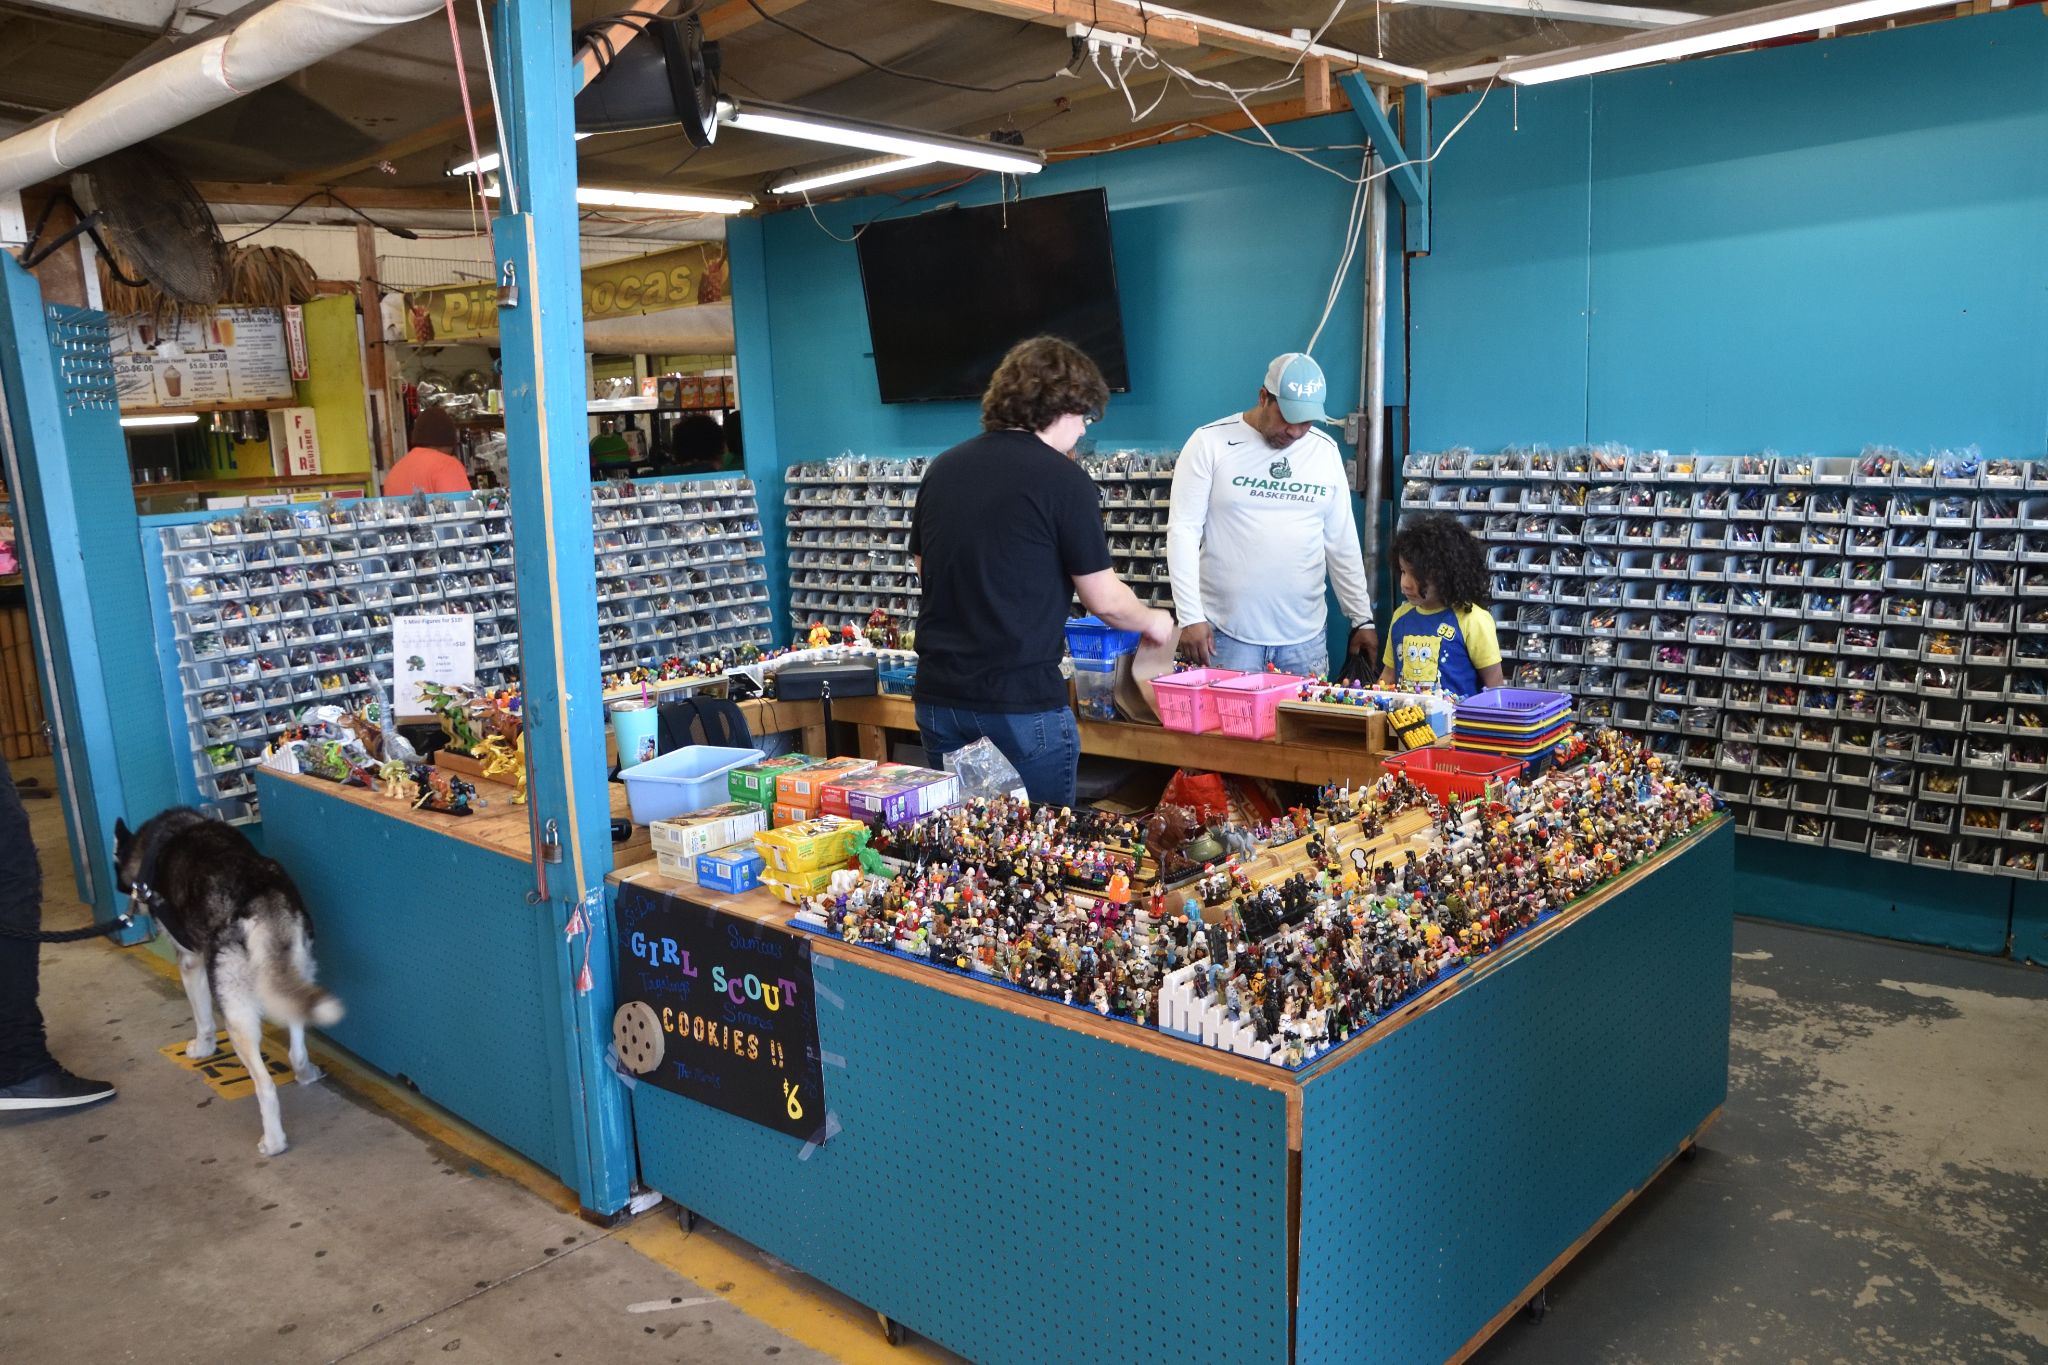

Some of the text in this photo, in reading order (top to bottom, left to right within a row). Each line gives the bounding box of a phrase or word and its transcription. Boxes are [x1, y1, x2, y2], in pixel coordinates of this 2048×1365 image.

[442, 289, 498, 333] Piñ
[1232, 476, 1327, 497] CHARLOTTE
[1249, 489, 1316, 503] BASKETBALL
[631, 930, 798, 1012] GIRL SCOUT
[662, 1006, 760, 1061] COOKIES
[783, 1077, 804, 1120] $6
